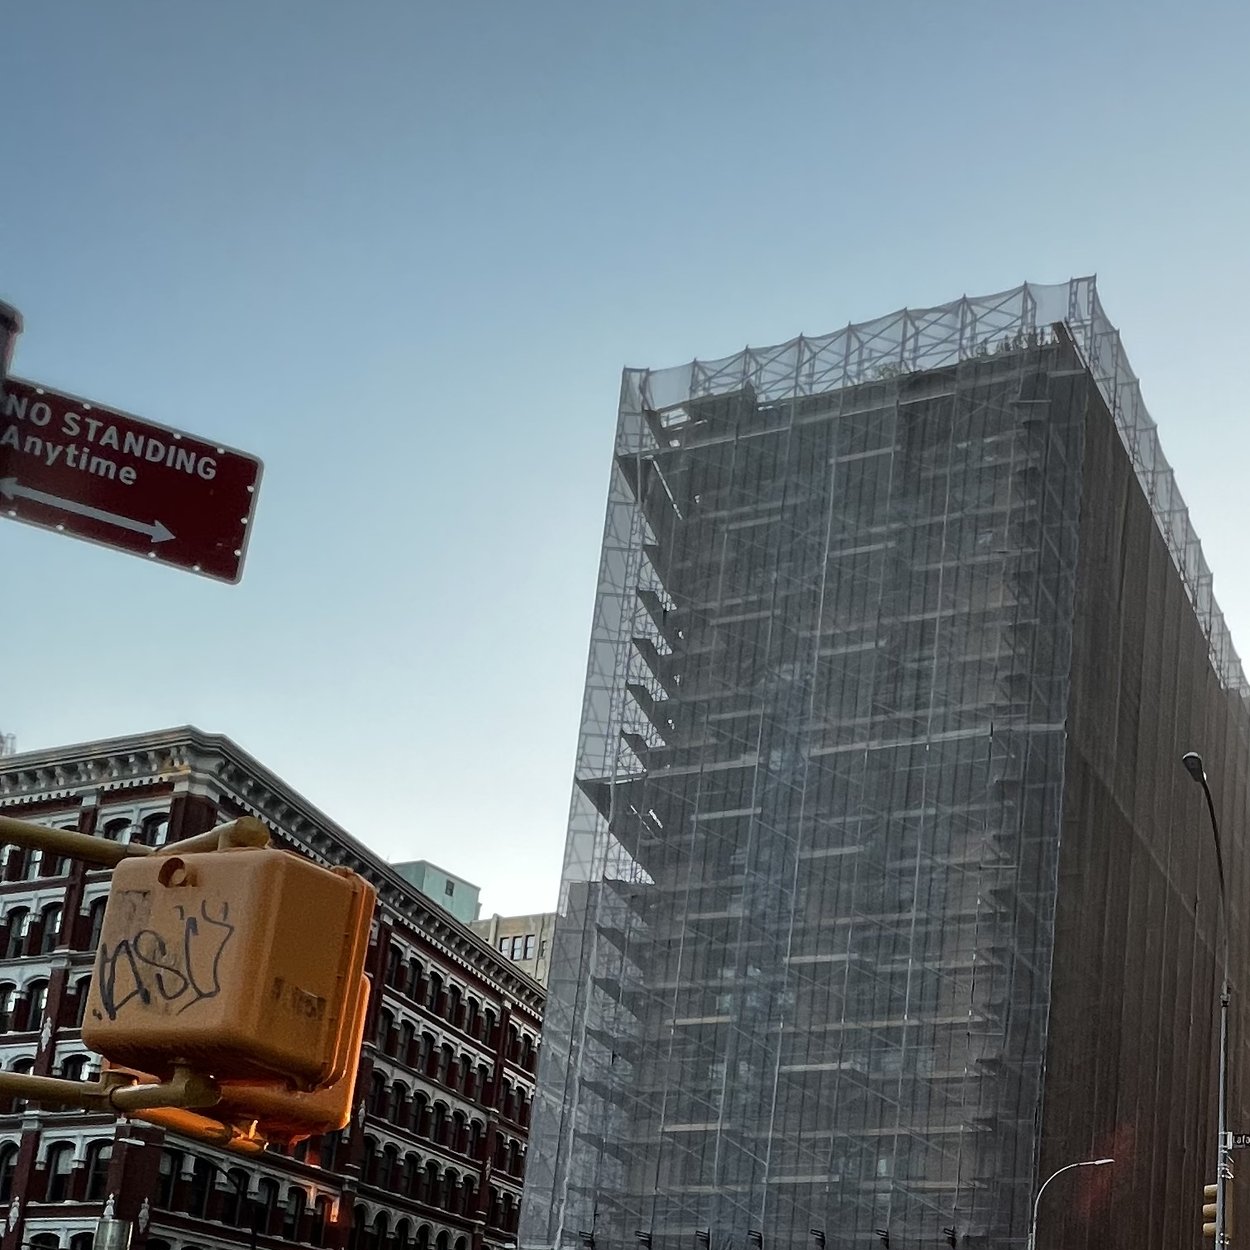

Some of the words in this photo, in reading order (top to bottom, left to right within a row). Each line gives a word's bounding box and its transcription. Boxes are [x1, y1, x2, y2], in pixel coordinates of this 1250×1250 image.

[0, 424, 138, 486] Anytime
[5, 394, 52, 427] NO
[61, 411, 218, 480] STANDING
